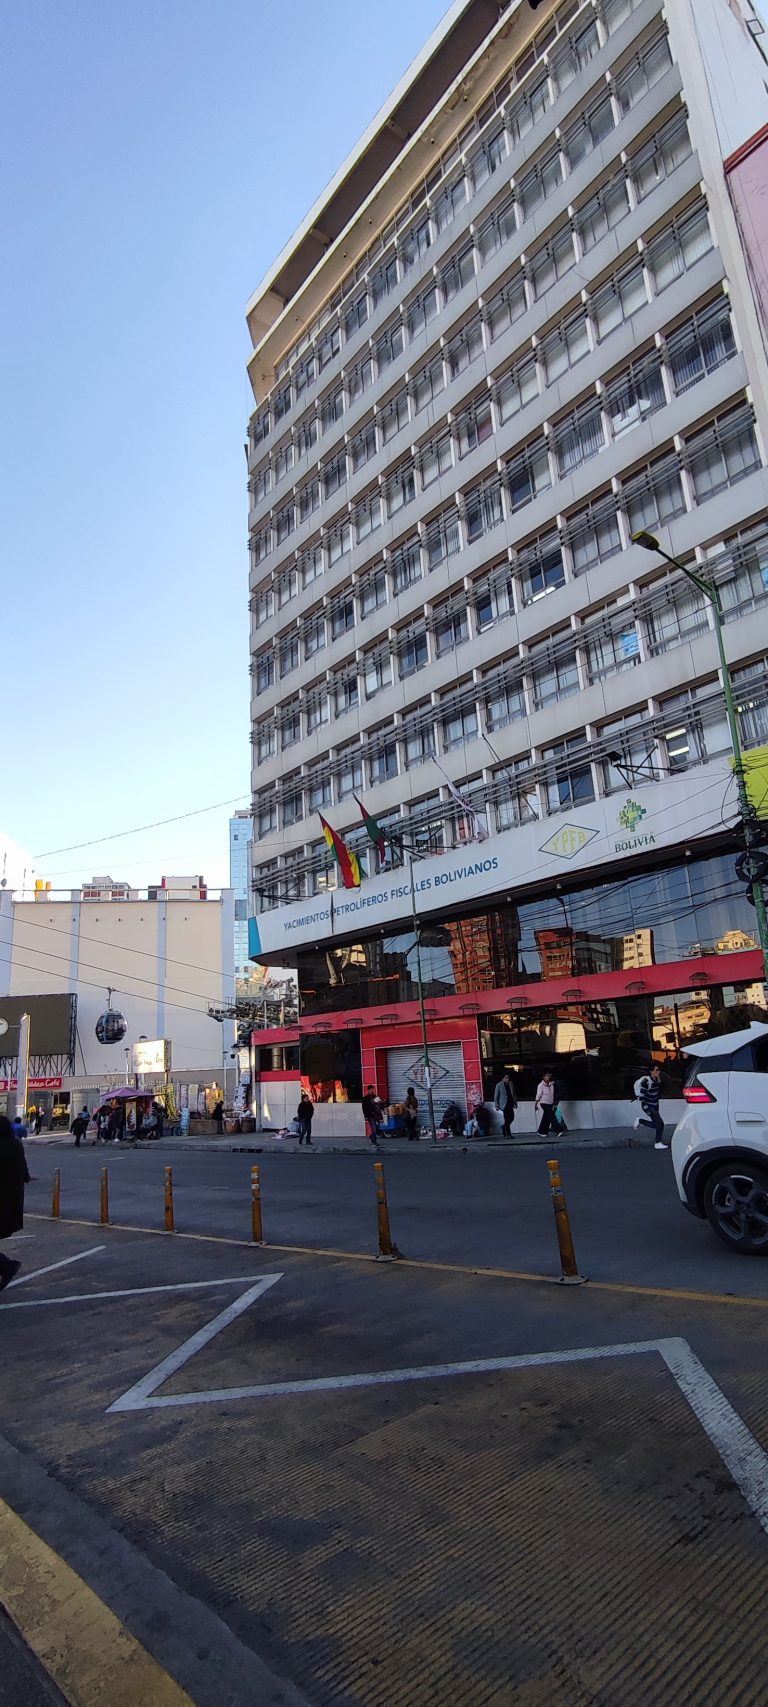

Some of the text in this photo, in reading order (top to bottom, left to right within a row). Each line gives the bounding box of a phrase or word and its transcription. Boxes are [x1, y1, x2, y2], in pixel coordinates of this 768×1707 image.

[551, 829, 586, 852] YPFB
[614, 834, 656, 853] BOLIVIA
[283, 857, 499, 931] YACIMIENTOS PETROLÍFEROS FISCALES BOLIVIANOS
